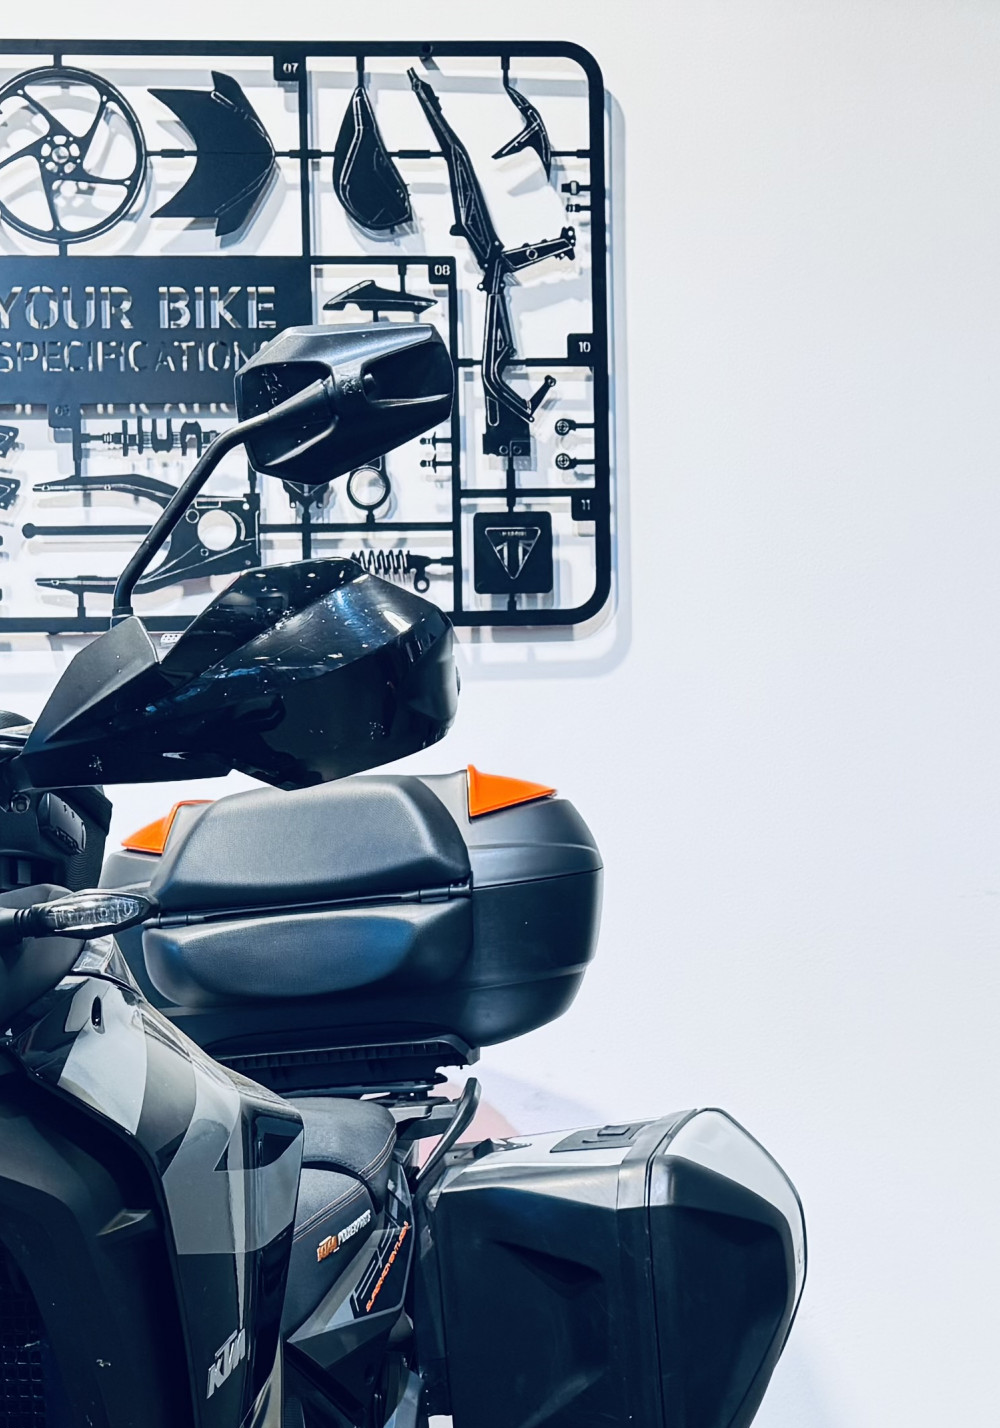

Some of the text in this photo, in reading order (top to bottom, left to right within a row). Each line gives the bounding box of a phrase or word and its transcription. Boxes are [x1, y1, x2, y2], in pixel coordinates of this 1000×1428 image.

[283, 62, 299, 74] 07
[434, 264, 451, 276] 08
[158, 286, 277, 329] BIKE
[578, 341, 592, 353] 10
[581, 499, 591, 511] 11
[206, 1328, 246, 1399] KTM
